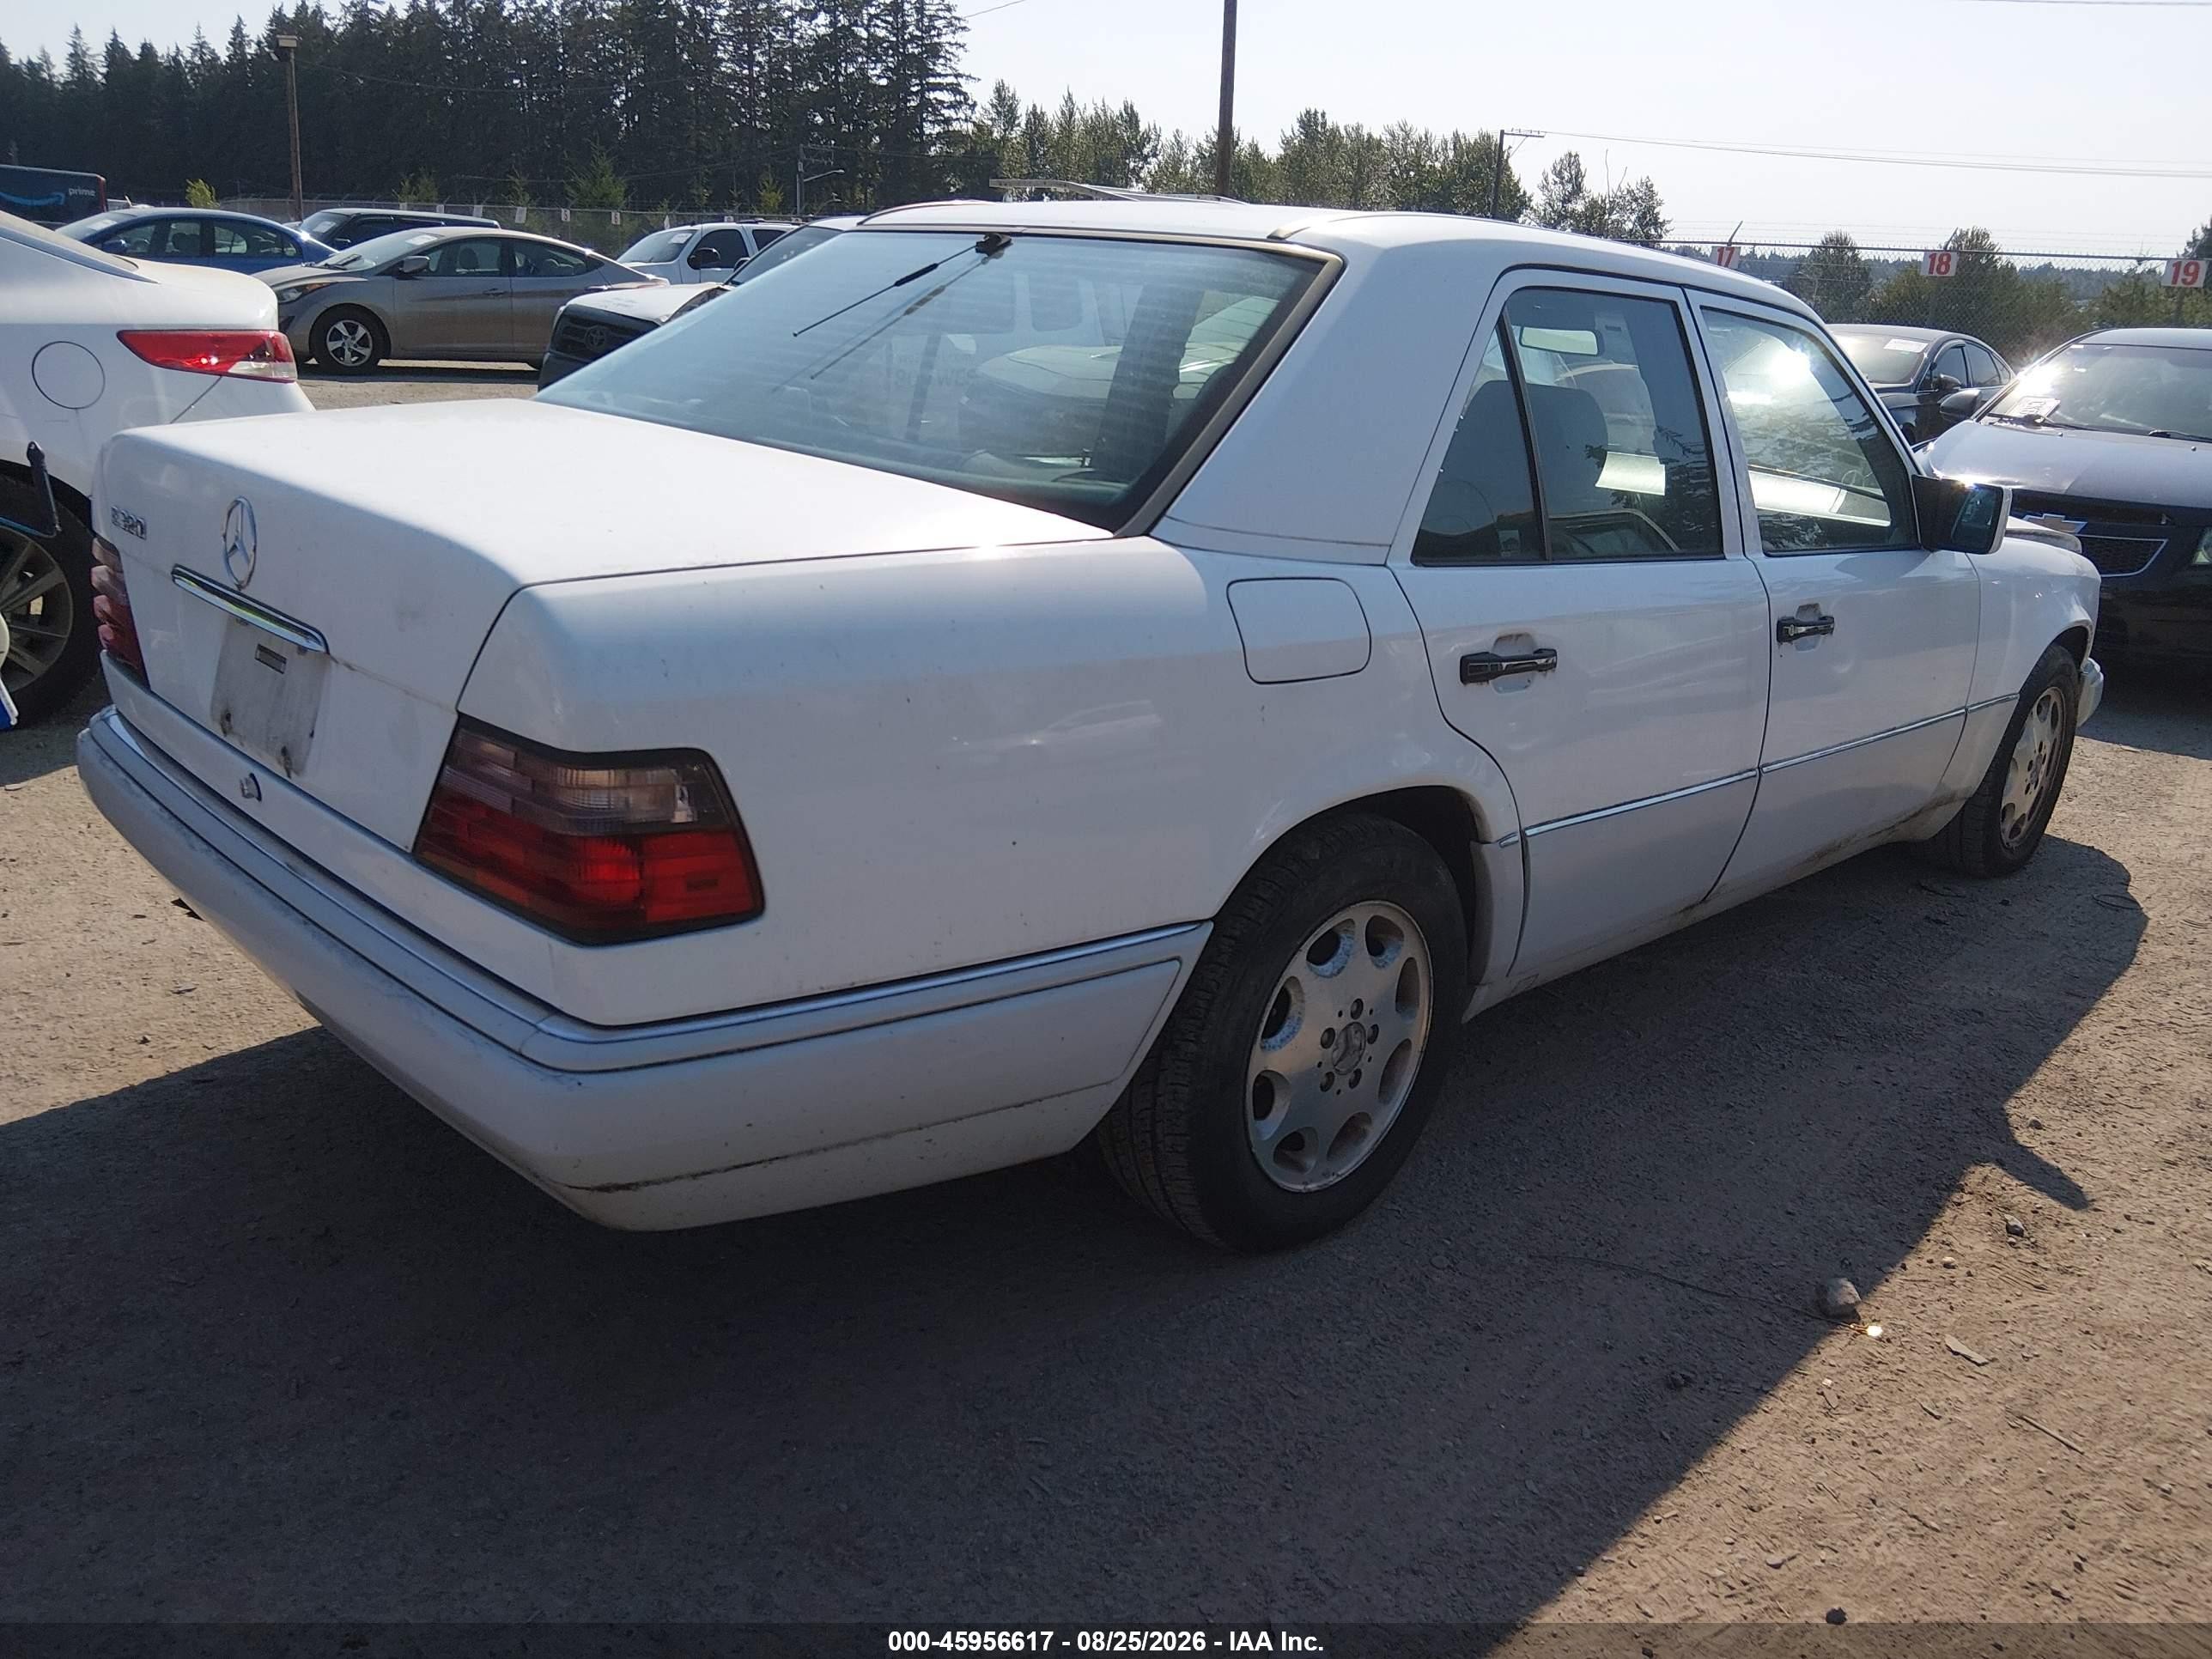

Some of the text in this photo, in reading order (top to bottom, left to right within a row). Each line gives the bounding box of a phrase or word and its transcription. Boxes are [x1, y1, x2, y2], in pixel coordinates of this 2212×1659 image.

[68, 185, 96, 198] prime
[1717, 246, 1735, 268] 17
[1928, 252, 1952, 276] 18
[2171, 260, 2200, 285] 19
